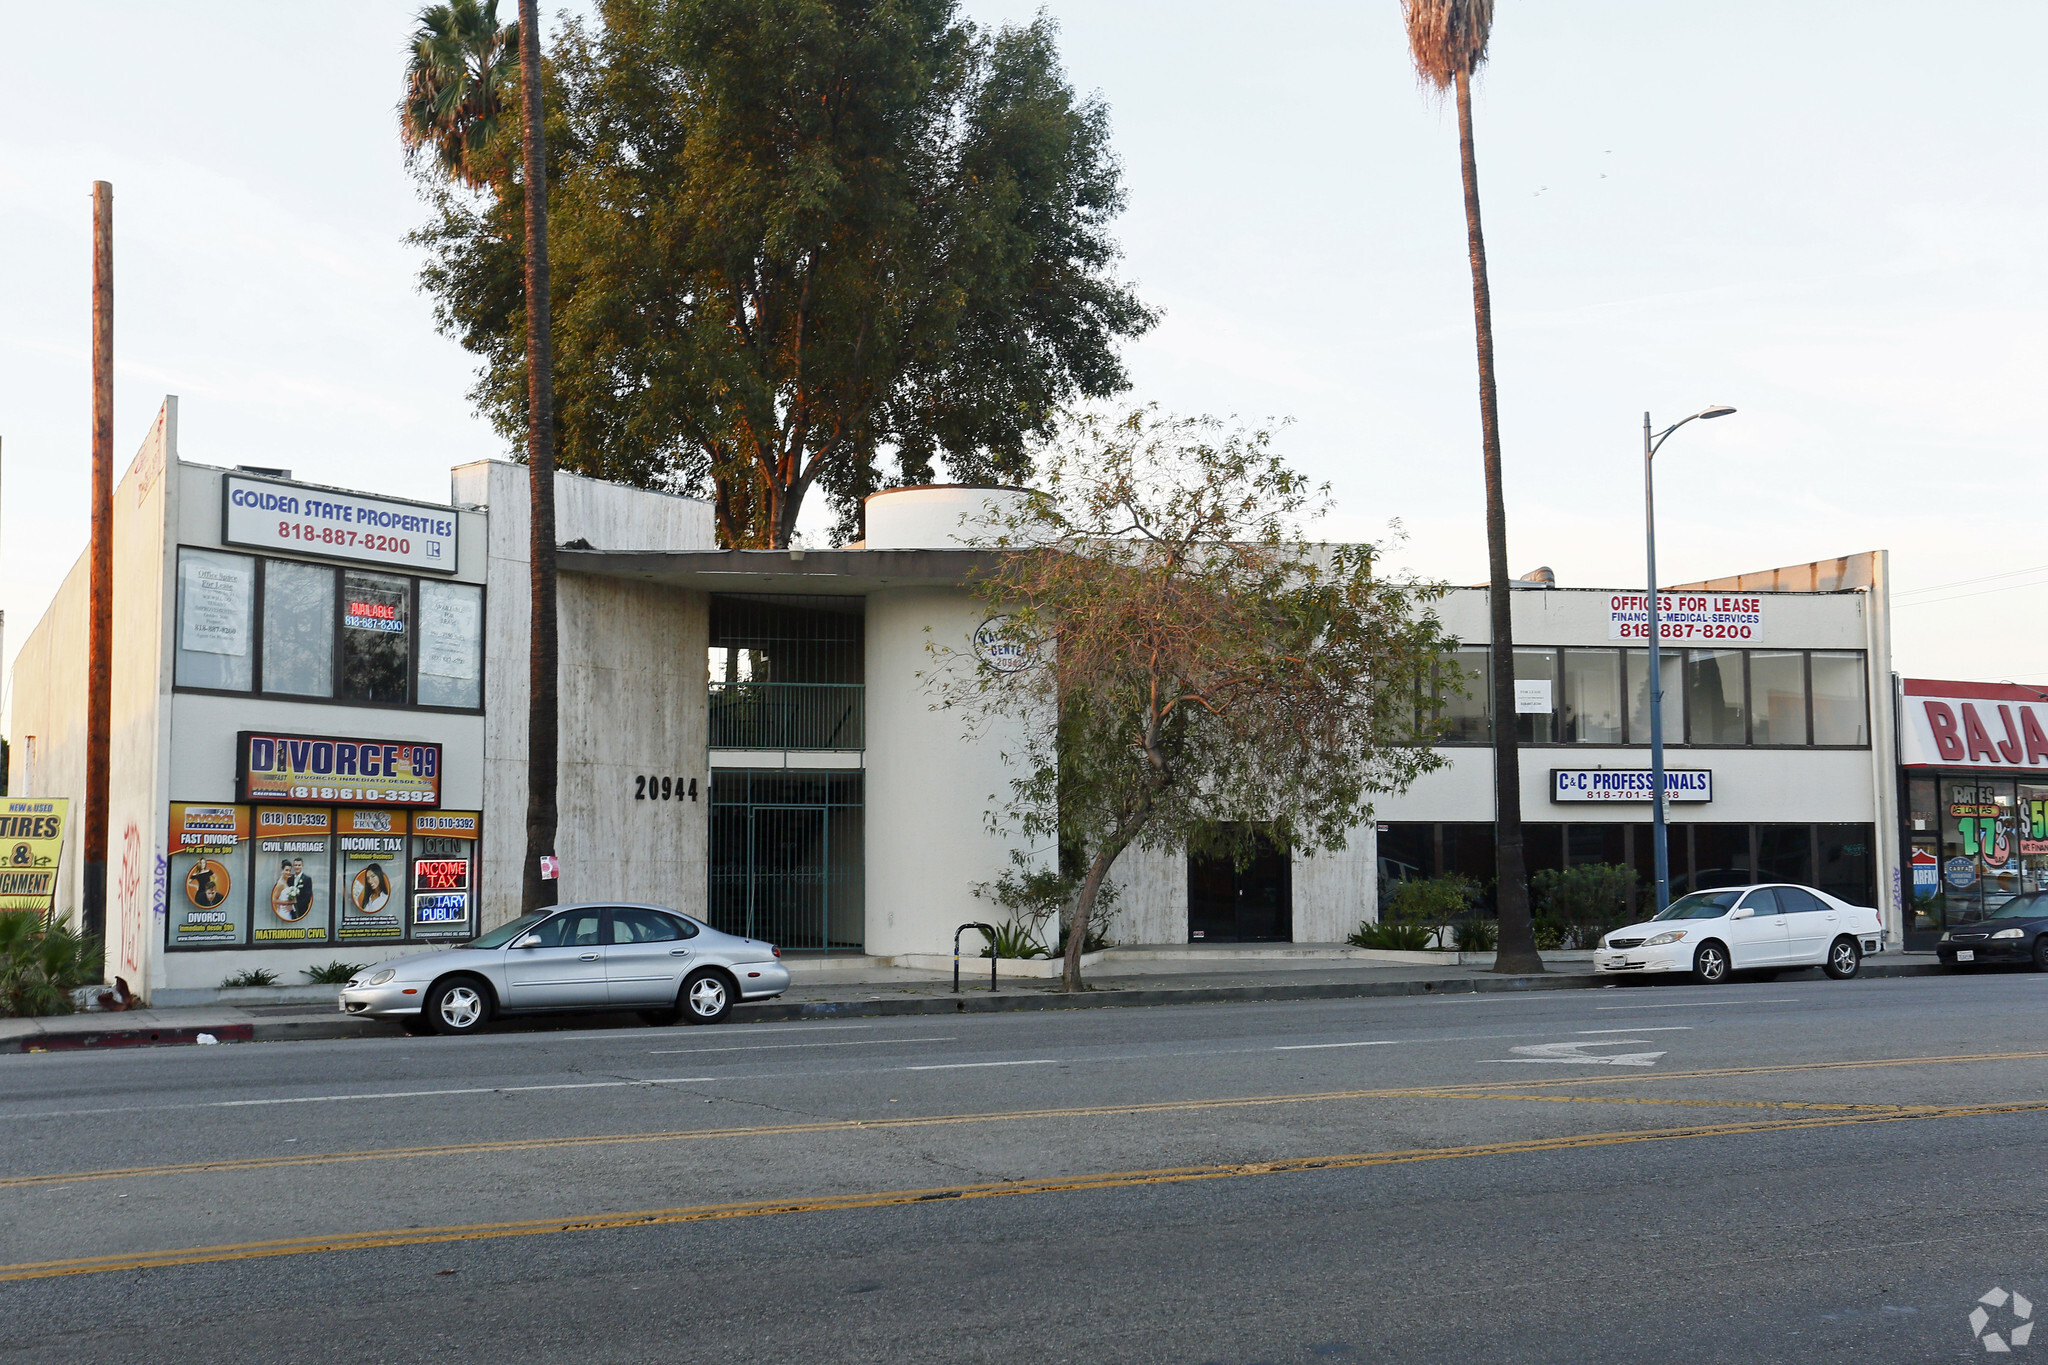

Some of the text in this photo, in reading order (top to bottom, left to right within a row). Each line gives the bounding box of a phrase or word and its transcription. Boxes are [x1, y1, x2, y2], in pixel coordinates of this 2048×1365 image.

[231, 488, 452, 537] GOLDEN STATE PROPERTIES
[278, 521, 410, 555] 818-887-8200
[350, 602, 396, 619] AVAILABLE
[1678, 596, 1707, 612] FOR
[1714, 597, 1760, 613] LEASE
[344, 615, 403, 631] 818-887-8200
[1611, 612, 1760, 624] FINANCL-MEDICAL-SERVICES
[1620, 623, 1752, 639] 818887-8200
[991, 643, 1027, 657] CENTE
[1923, 700, 2048, 764] BAJA
[251, 737, 399, 777] DIVORCE
[635, 775, 698, 802] 20944
[1593, 773, 1706, 790] PROFESSNALS
[1586, 791, 1680, 799] 818-701-538
[1952, 786, 1994, 804] RATES
[9, 803, 53, 813] NEW & USED
[186, 813, 234, 824] DIVORCE
[261, 812, 327, 826] (818) 610-3392
[417, 816, 475, 829] (818) 610-3392
[0, 815, 59, 838] TIRES
[180, 833, 238, 845] FAST DIVORCE
[341, 837, 402, 851] INCOME TAX
[423, 837, 462, 855] OPEN
[262, 841, 324, 852] CIVIL MARRIAGE
[13, 844, 30, 865] &
[416, 862, 467, 876] INCOME
[427, 875, 458, 888] TAX
[1912, 869, 1937, 885] ARFAX
[416, 895, 466, 909] NOTARY
[188, 912, 226, 923] DIVORCIO
[422, 908, 460, 922] PUBLIC
[255, 929, 305, 940] MATRIMONIO
[307, 928, 326, 938] CIVIL
